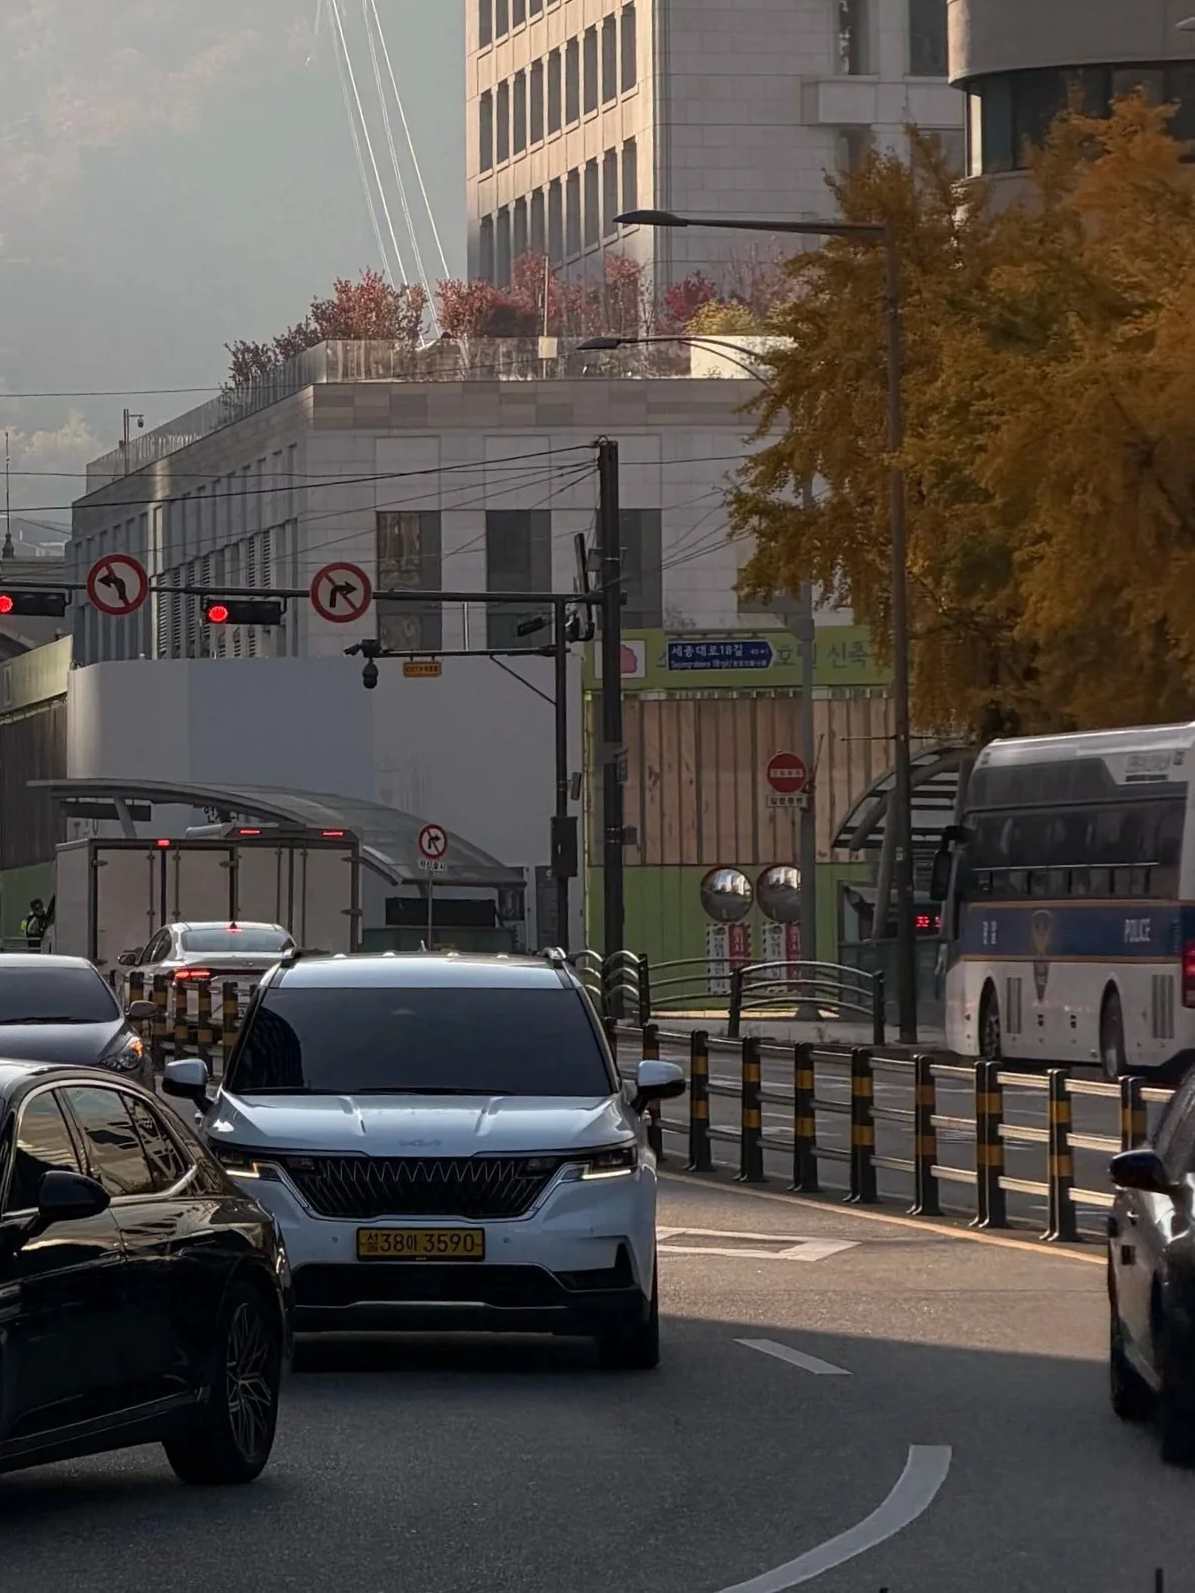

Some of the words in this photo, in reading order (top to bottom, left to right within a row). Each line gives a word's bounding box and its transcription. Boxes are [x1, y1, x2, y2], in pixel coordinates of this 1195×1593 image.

[671, 644, 743, 657] 세종대로18길
[1124, 918, 1151, 943] POLICE
[423, 1233, 475, 1253] 3590
